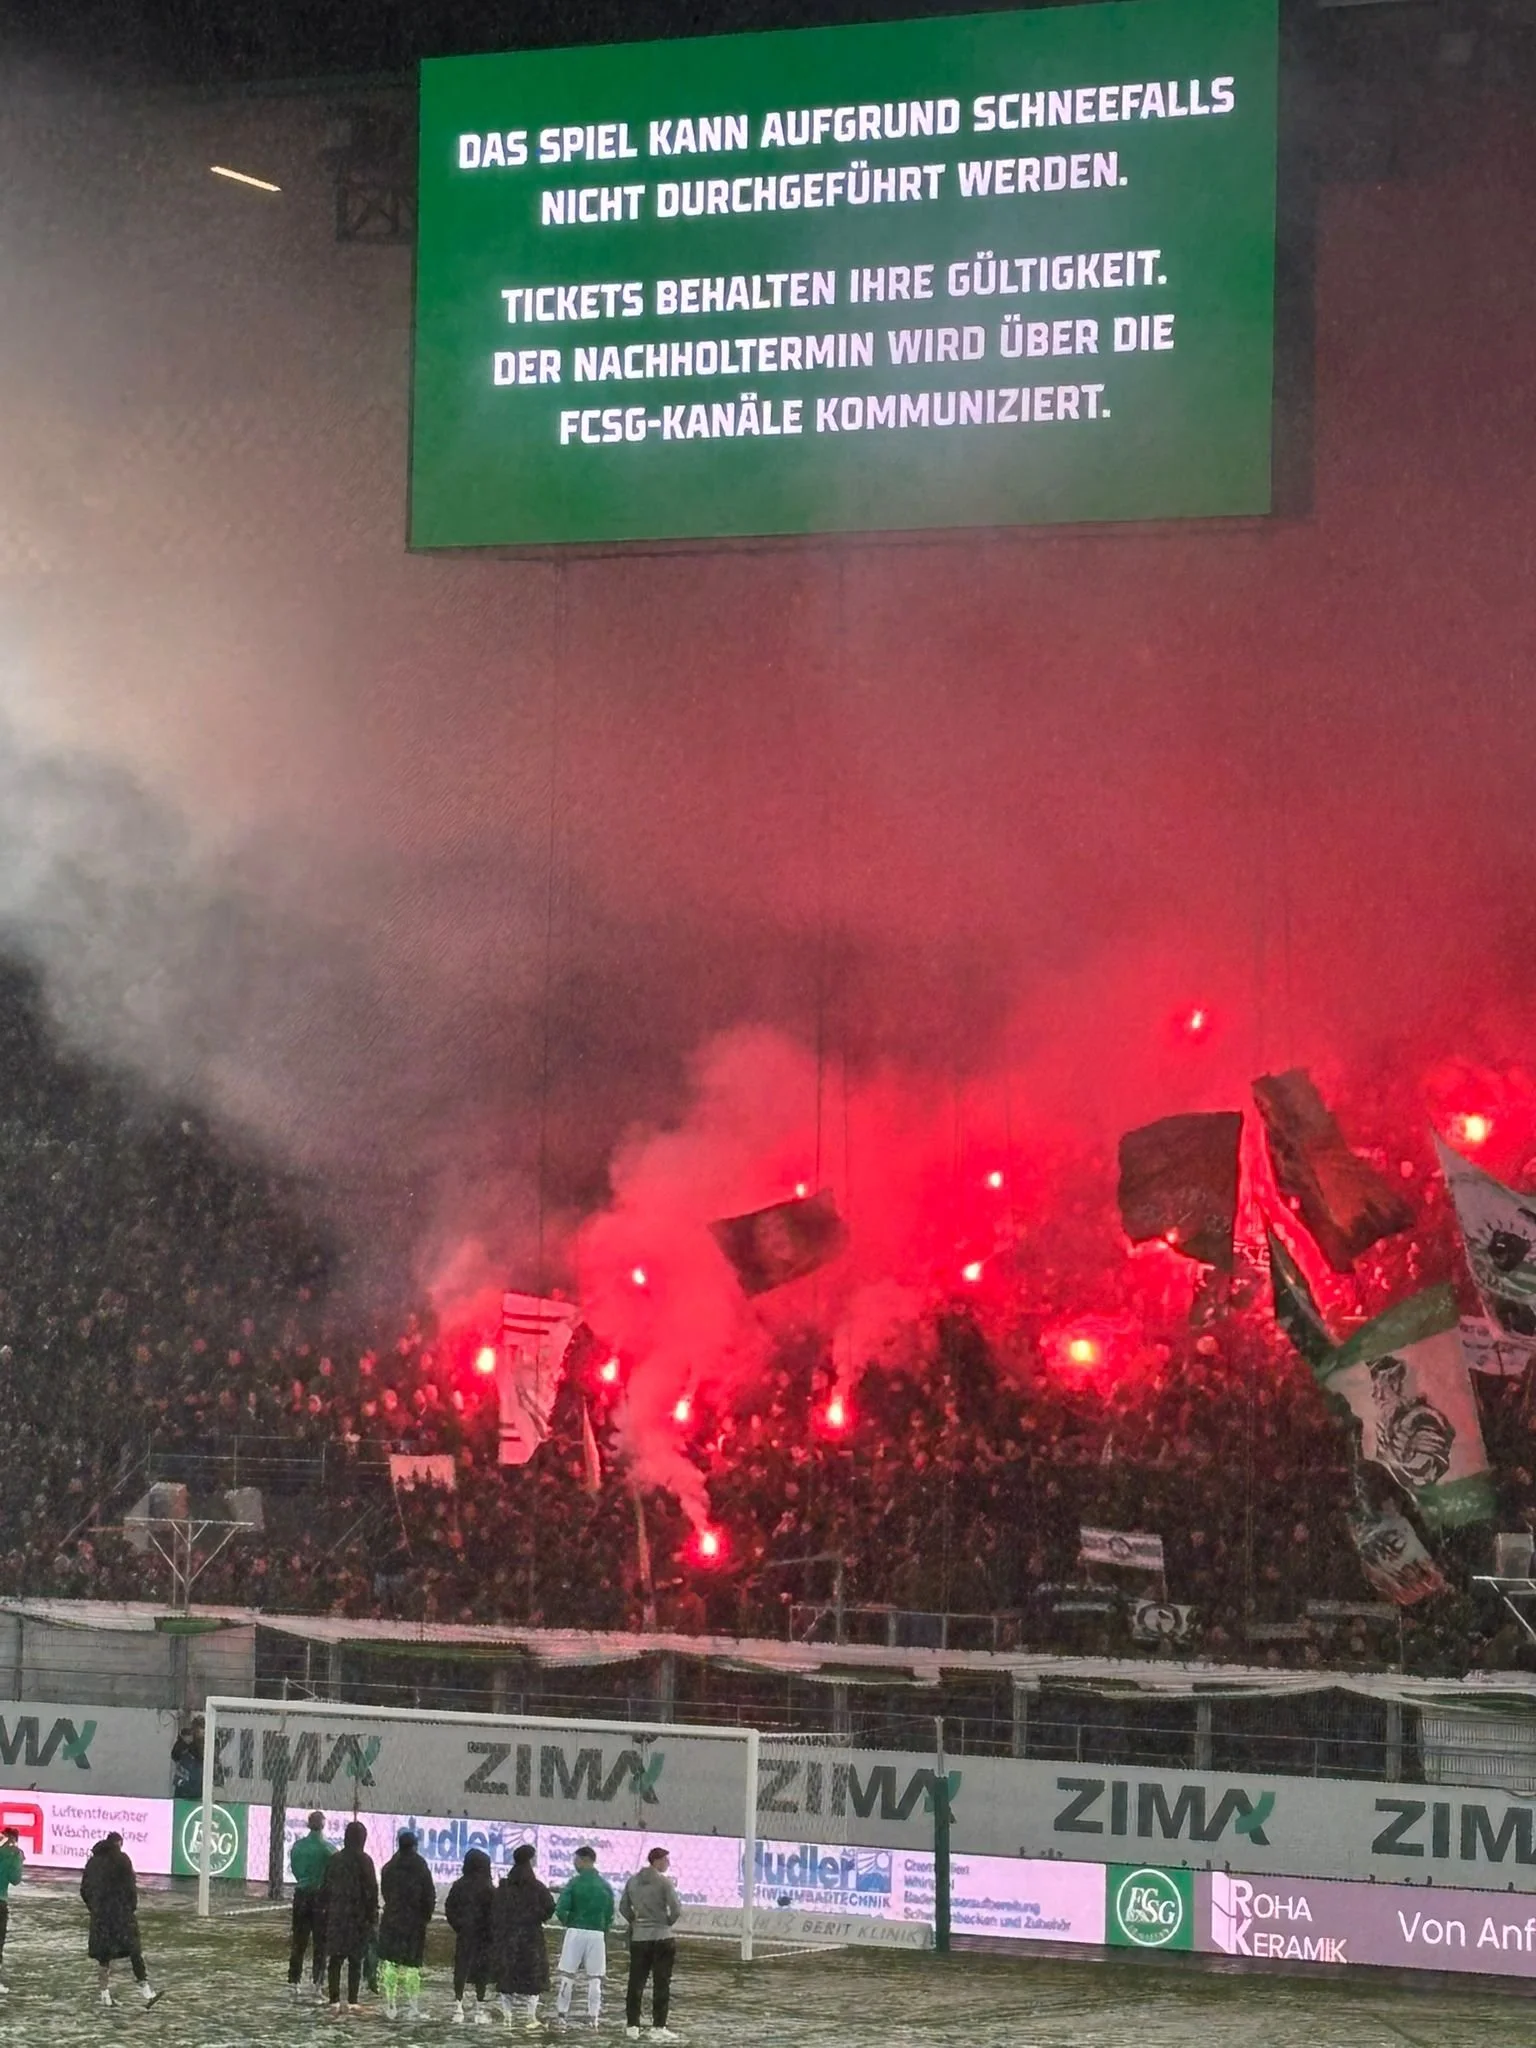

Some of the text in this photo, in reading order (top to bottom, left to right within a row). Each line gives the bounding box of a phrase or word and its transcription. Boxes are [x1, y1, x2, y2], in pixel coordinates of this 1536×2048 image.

[459, 76, 1235, 169] DAS SPIEL KANN AUFGRUND SCHNEEFALLS
[541, 151, 1128, 226] NICHT DURCHGEFÜHRT WERDEN.
[502, 249, 1167, 324] TICKETS BEHALTEN IHRE GÜLTIGKEIT.
[493, 313, 1175, 386] DER NACHHOLTERMIN WIRD ÜBER DIE
[560, 383, 1111, 445] FCSG-KANÄLE KOMMUNIZIERT.
[464, 1741, 665, 1804] ZIMAX
[51, 1823, 148, 1843] Wäschetrkner
[1054, 1777, 1277, 1846] ZIMAX
[736, 1886, 892, 1908] SHWIMMBADTECHNIK
[1229, 1878, 1313, 1922] ROHA
[1228, 1918, 1348, 1964] KERAMIK
[1398, 1910, 1466, 1947] Von
